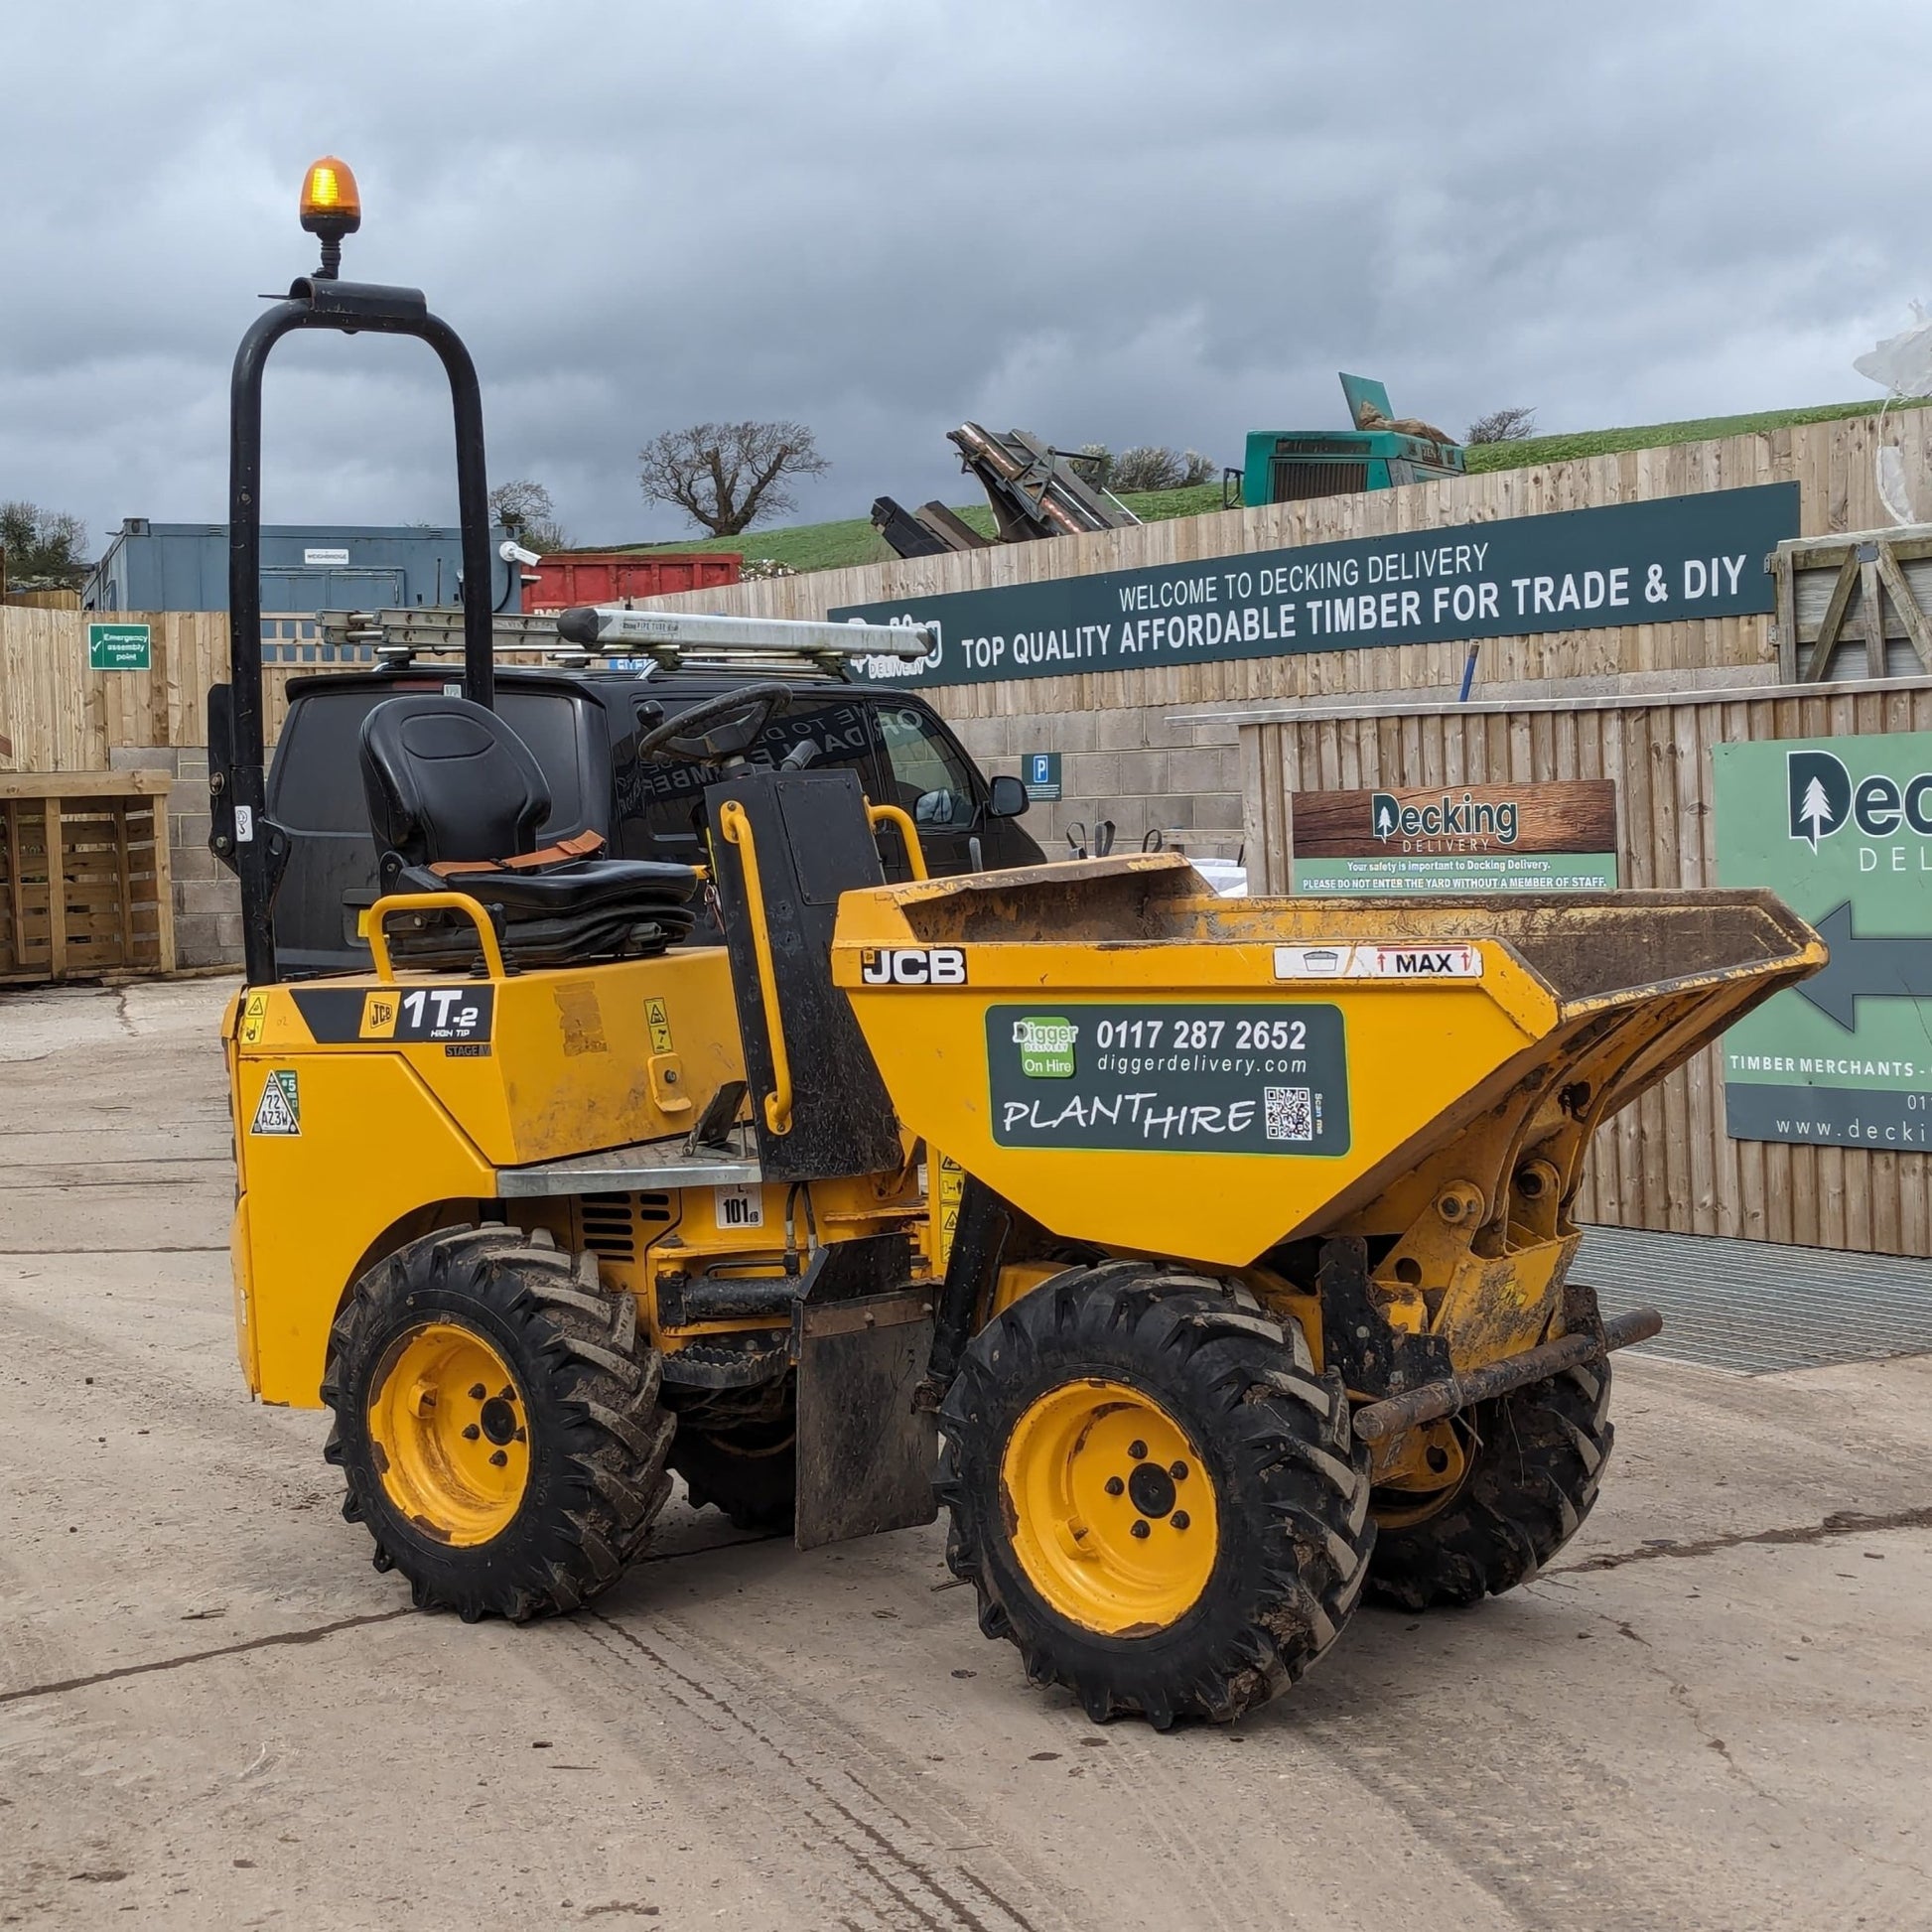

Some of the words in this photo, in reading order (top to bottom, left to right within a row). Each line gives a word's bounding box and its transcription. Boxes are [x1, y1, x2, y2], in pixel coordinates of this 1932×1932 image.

[1119, 576, 1218, 612] WELCOME
[1224, 572, 1252, 600] TO
[1260, 559, 1359, 597] DECKING
[1368, 542, 1489, 584] DELIVERY
[961, 636, 1005, 668] TOP
[1013, 623, 1112, 665] QUALITY
[1119, 604, 1296, 654] AFFORDABLE
[1306, 591, 1422, 635] TIMBER
[1434, 582, 1500, 623] FOR
[1511, 567, 1630, 616] TRADE
[1644, 563, 1669, 604] &
[1684, 554, 1747, 600] DIY
[103, 633, 148, 643] Emergency
[107, 643, 145, 652] assembly
[1037, 759, 1046, 779] P
[1372, 792, 1519, 845] Decking
[1402, 839, 1489, 853] DELIVERY
[1347, 861, 1368, 872] Your
[1369, 861, 1396, 874] safety
[1398, 861, 1407, 871] is
[1408, 860, 1453, 873] important
[1455, 860, 1465, 871] to
[1467, 859, 1506, 872] Decking
[1508, 859, 1551, 872] Delivery.
[1303, 879, 1336, 889] PLEASE
[1338, 879, 1350, 889] DO
[1352, 879, 1371, 889] NOT
[1373, 879, 1403, 889] ENTER
[1405, 879, 1424, 889] THE
[1426, 879, 1450, 889] YARD
[1453, 878, 1498, 888] WITHOUT
[1501, 878, 1508, 888] A
[1509, 878, 1554, 888] MEMBER
[1556, 877, 1569, 887] OF
[1572, 877, 1606, 887] STAFF.
[864, 950, 965, 984] JCB
[1396, 953, 1453, 973] MAX
[372, 1003, 391, 1026] JCB
[1013, 1022, 1079, 1044] Digger
[1097, 1021, 1163, 1049] 0117
[1173, 1021, 1224, 1049] 287
[1235, 1021, 1307, 1050] 2652
[446, 1045, 478, 1056] STAGE
[1025, 1059, 1043, 1072] On
[1046, 1059, 1072, 1072] Hire
[1097, 1054, 1308, 1075] diggerdelivery.com
[1729, 1055, 1795, 1071] TIMBER
[1800, 1057, 1914, 1077] MERCHANTS
[266, 1094, 280, 1110] 72
[723, 1198, 749, 1223] 101
